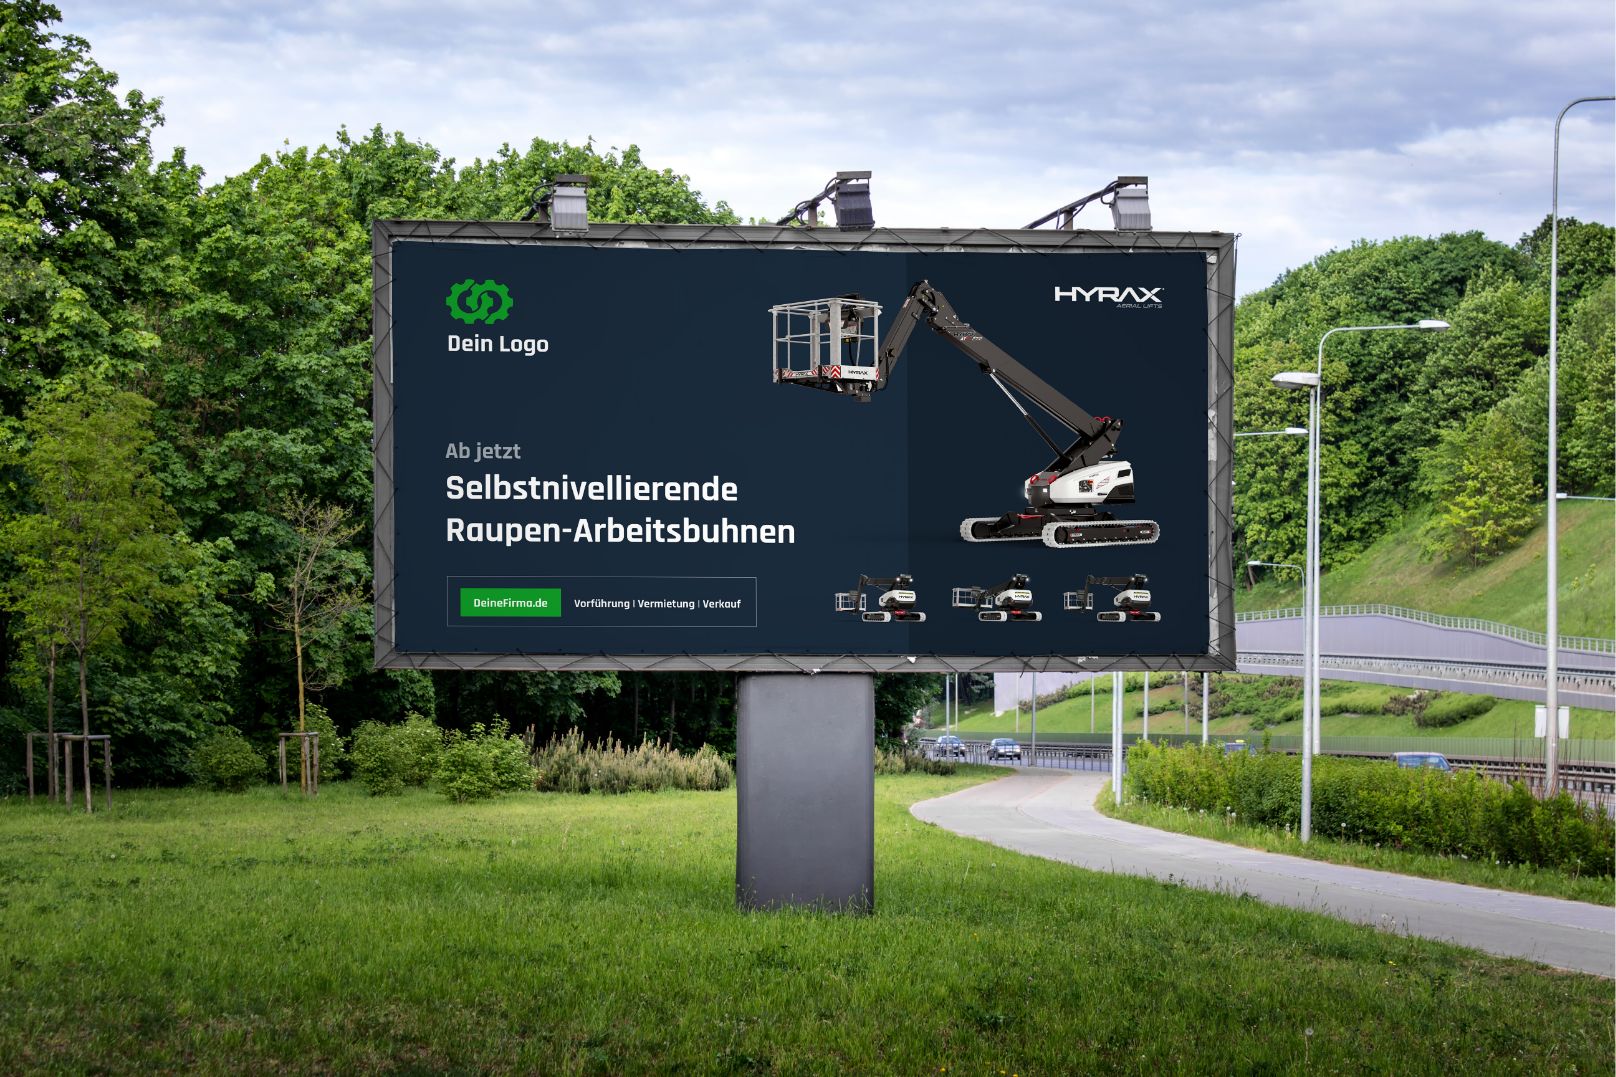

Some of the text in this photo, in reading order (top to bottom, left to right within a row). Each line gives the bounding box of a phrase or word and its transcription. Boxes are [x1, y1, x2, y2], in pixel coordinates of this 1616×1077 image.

[1055, 286, 1162, 303] HYRAX
[447, 333, 550, 357] Dein Logo
[445, 441, 522, 463] Ab jetzt
[446, 473, 738, 502] Selbstnivellierende
[446, 516, 796, 547] Raupen-Arbeitsbuhnen
[473, 598, 548, 608] DeineFirma.de
[573, 598, 631, 610] Vorführung
[637, 599, 696, 611] Vermietung
[702, 599, 742, 610] Verkauf
